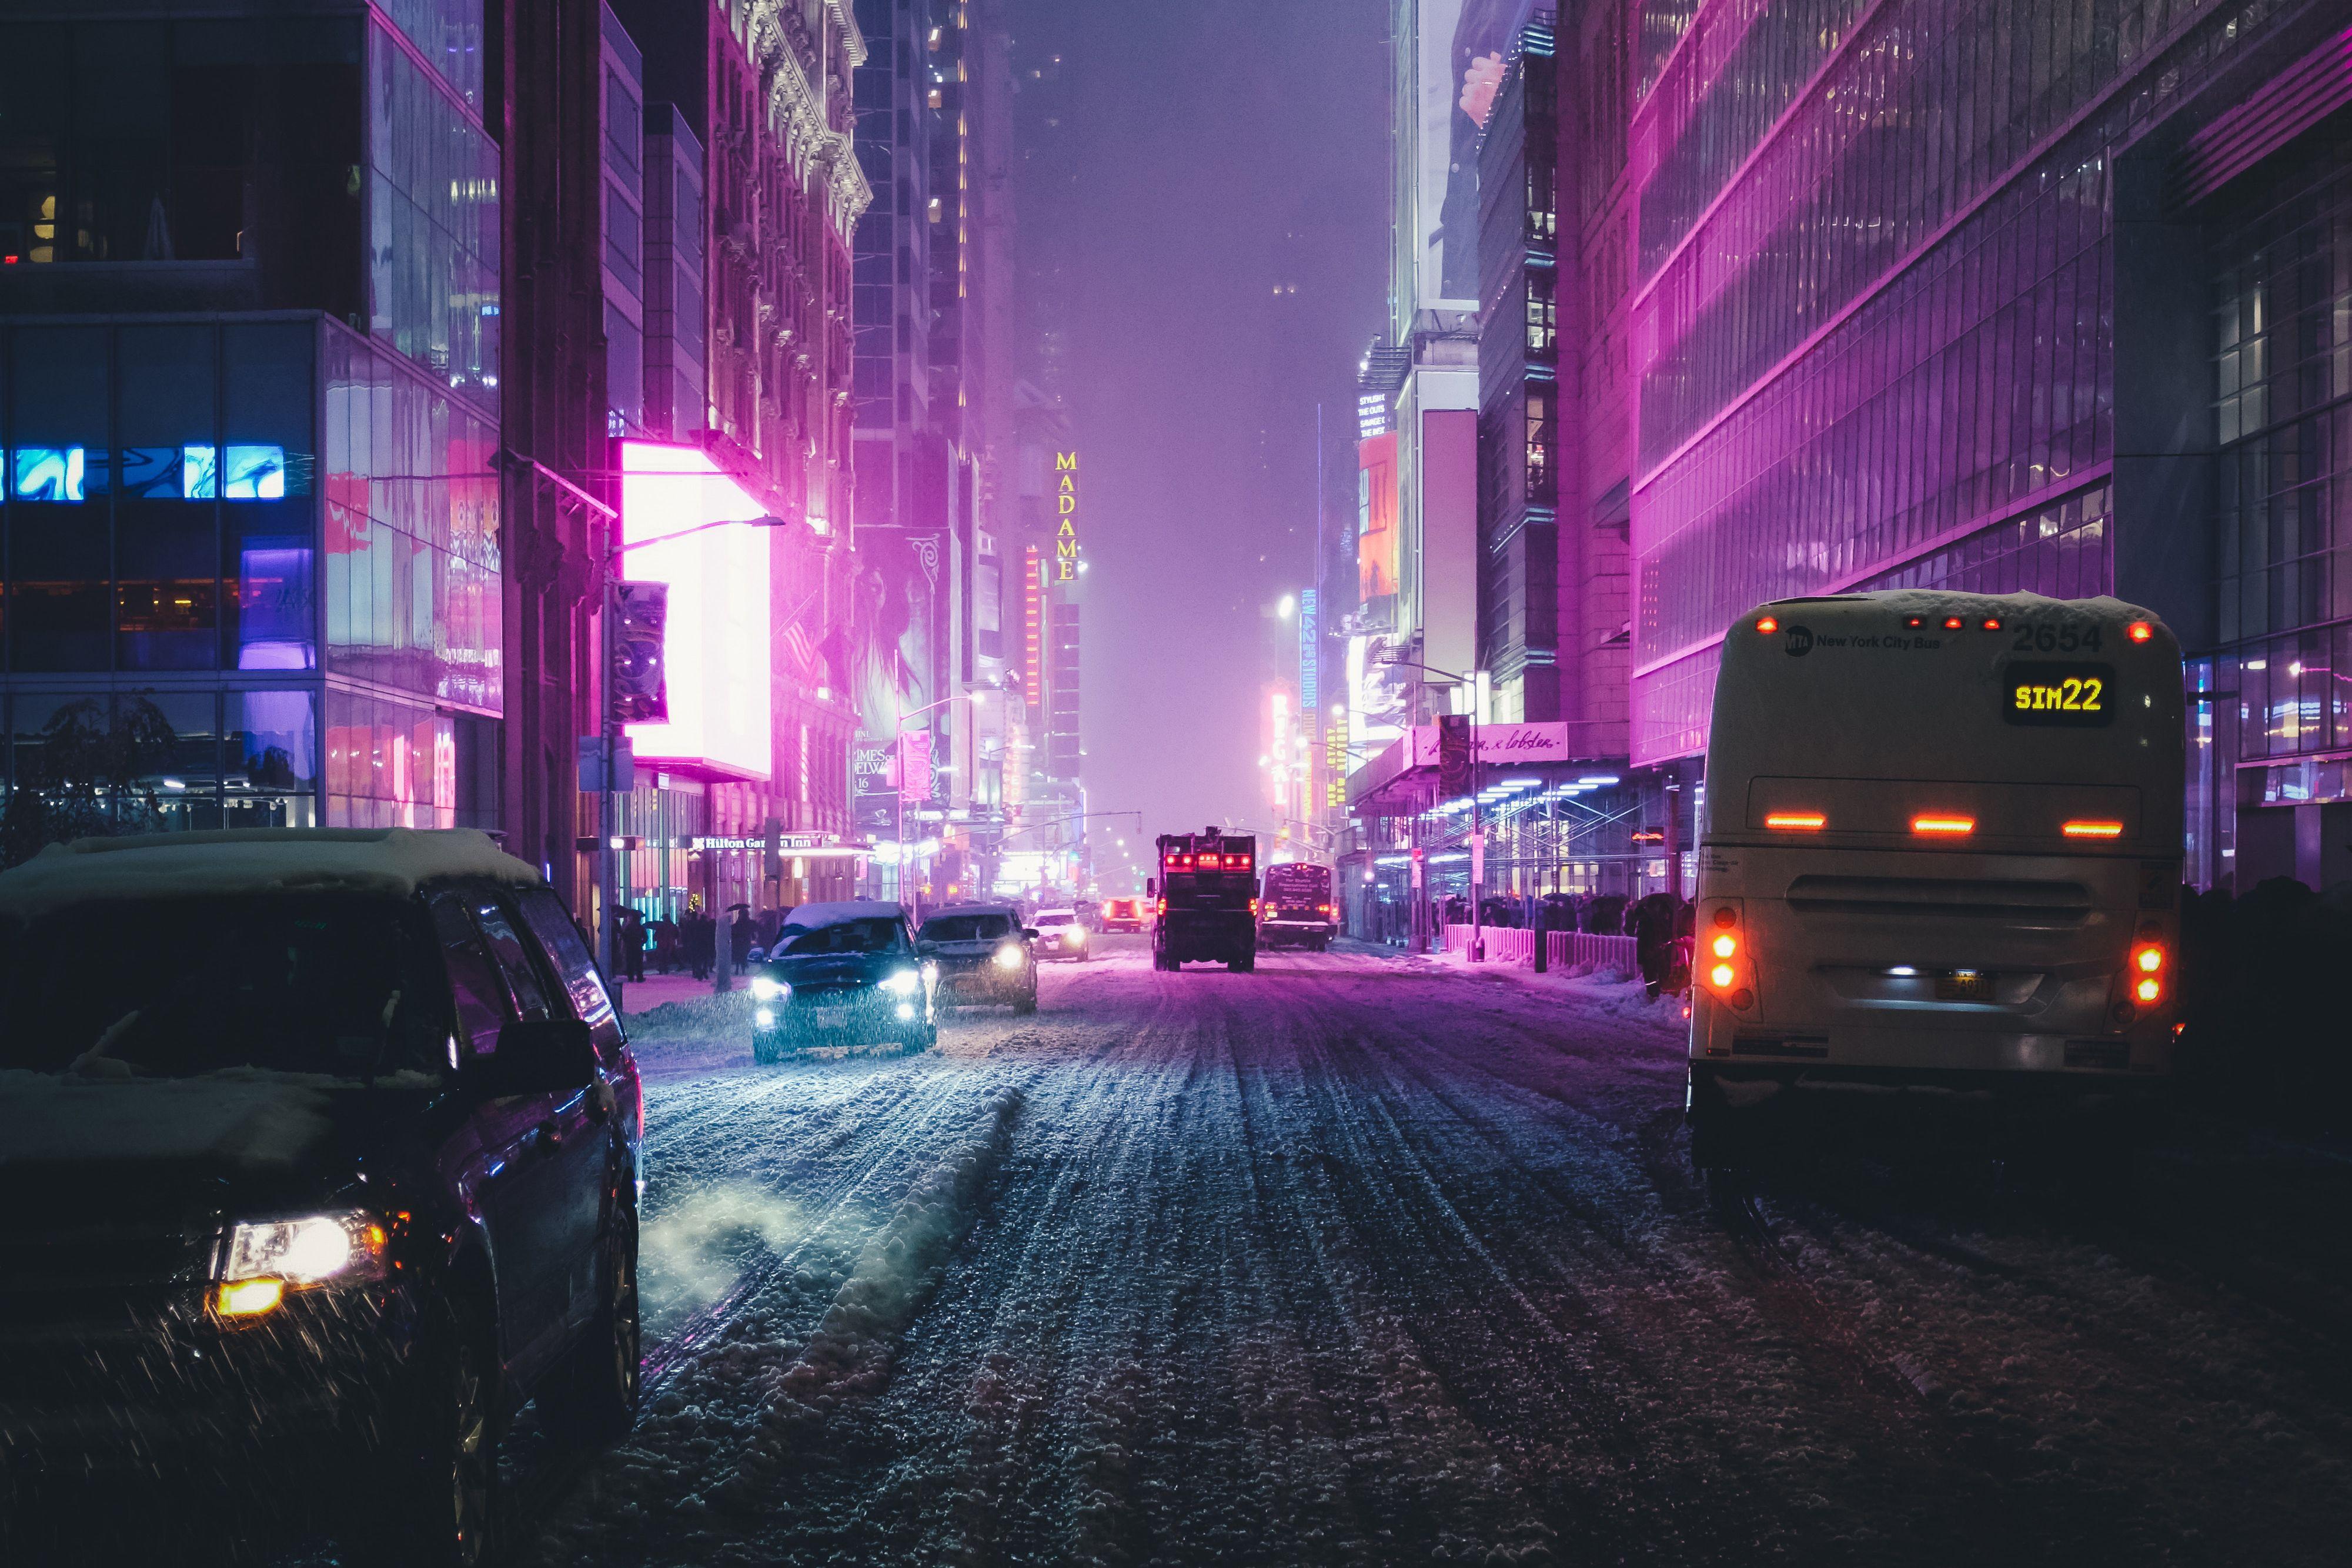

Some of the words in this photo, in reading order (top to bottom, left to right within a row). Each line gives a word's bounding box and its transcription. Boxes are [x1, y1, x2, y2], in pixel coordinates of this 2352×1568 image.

[1055, 452, 1077, 580] MADAME
[1302, 589, 1317, 615] NEW
[1816, 636, 1846, 647] New
[1850, 636, 1879, 647] York
[1883, 636, 1910, 650] City
[1914, 637, 1940, 650] Bus
[2012, 622, 2103, 653] 2654
[1302, 659, 1317, 708] STUDIOS
[2016, 678, 2102, 710] SIM22
[854, 748, 885, 761] IMES
[858, 777, 868, 788] 16
[706, 837, 744, 848] Hilton
[746, 837, 789, 848] Garn
[790, 837, 811, 847] Inn
